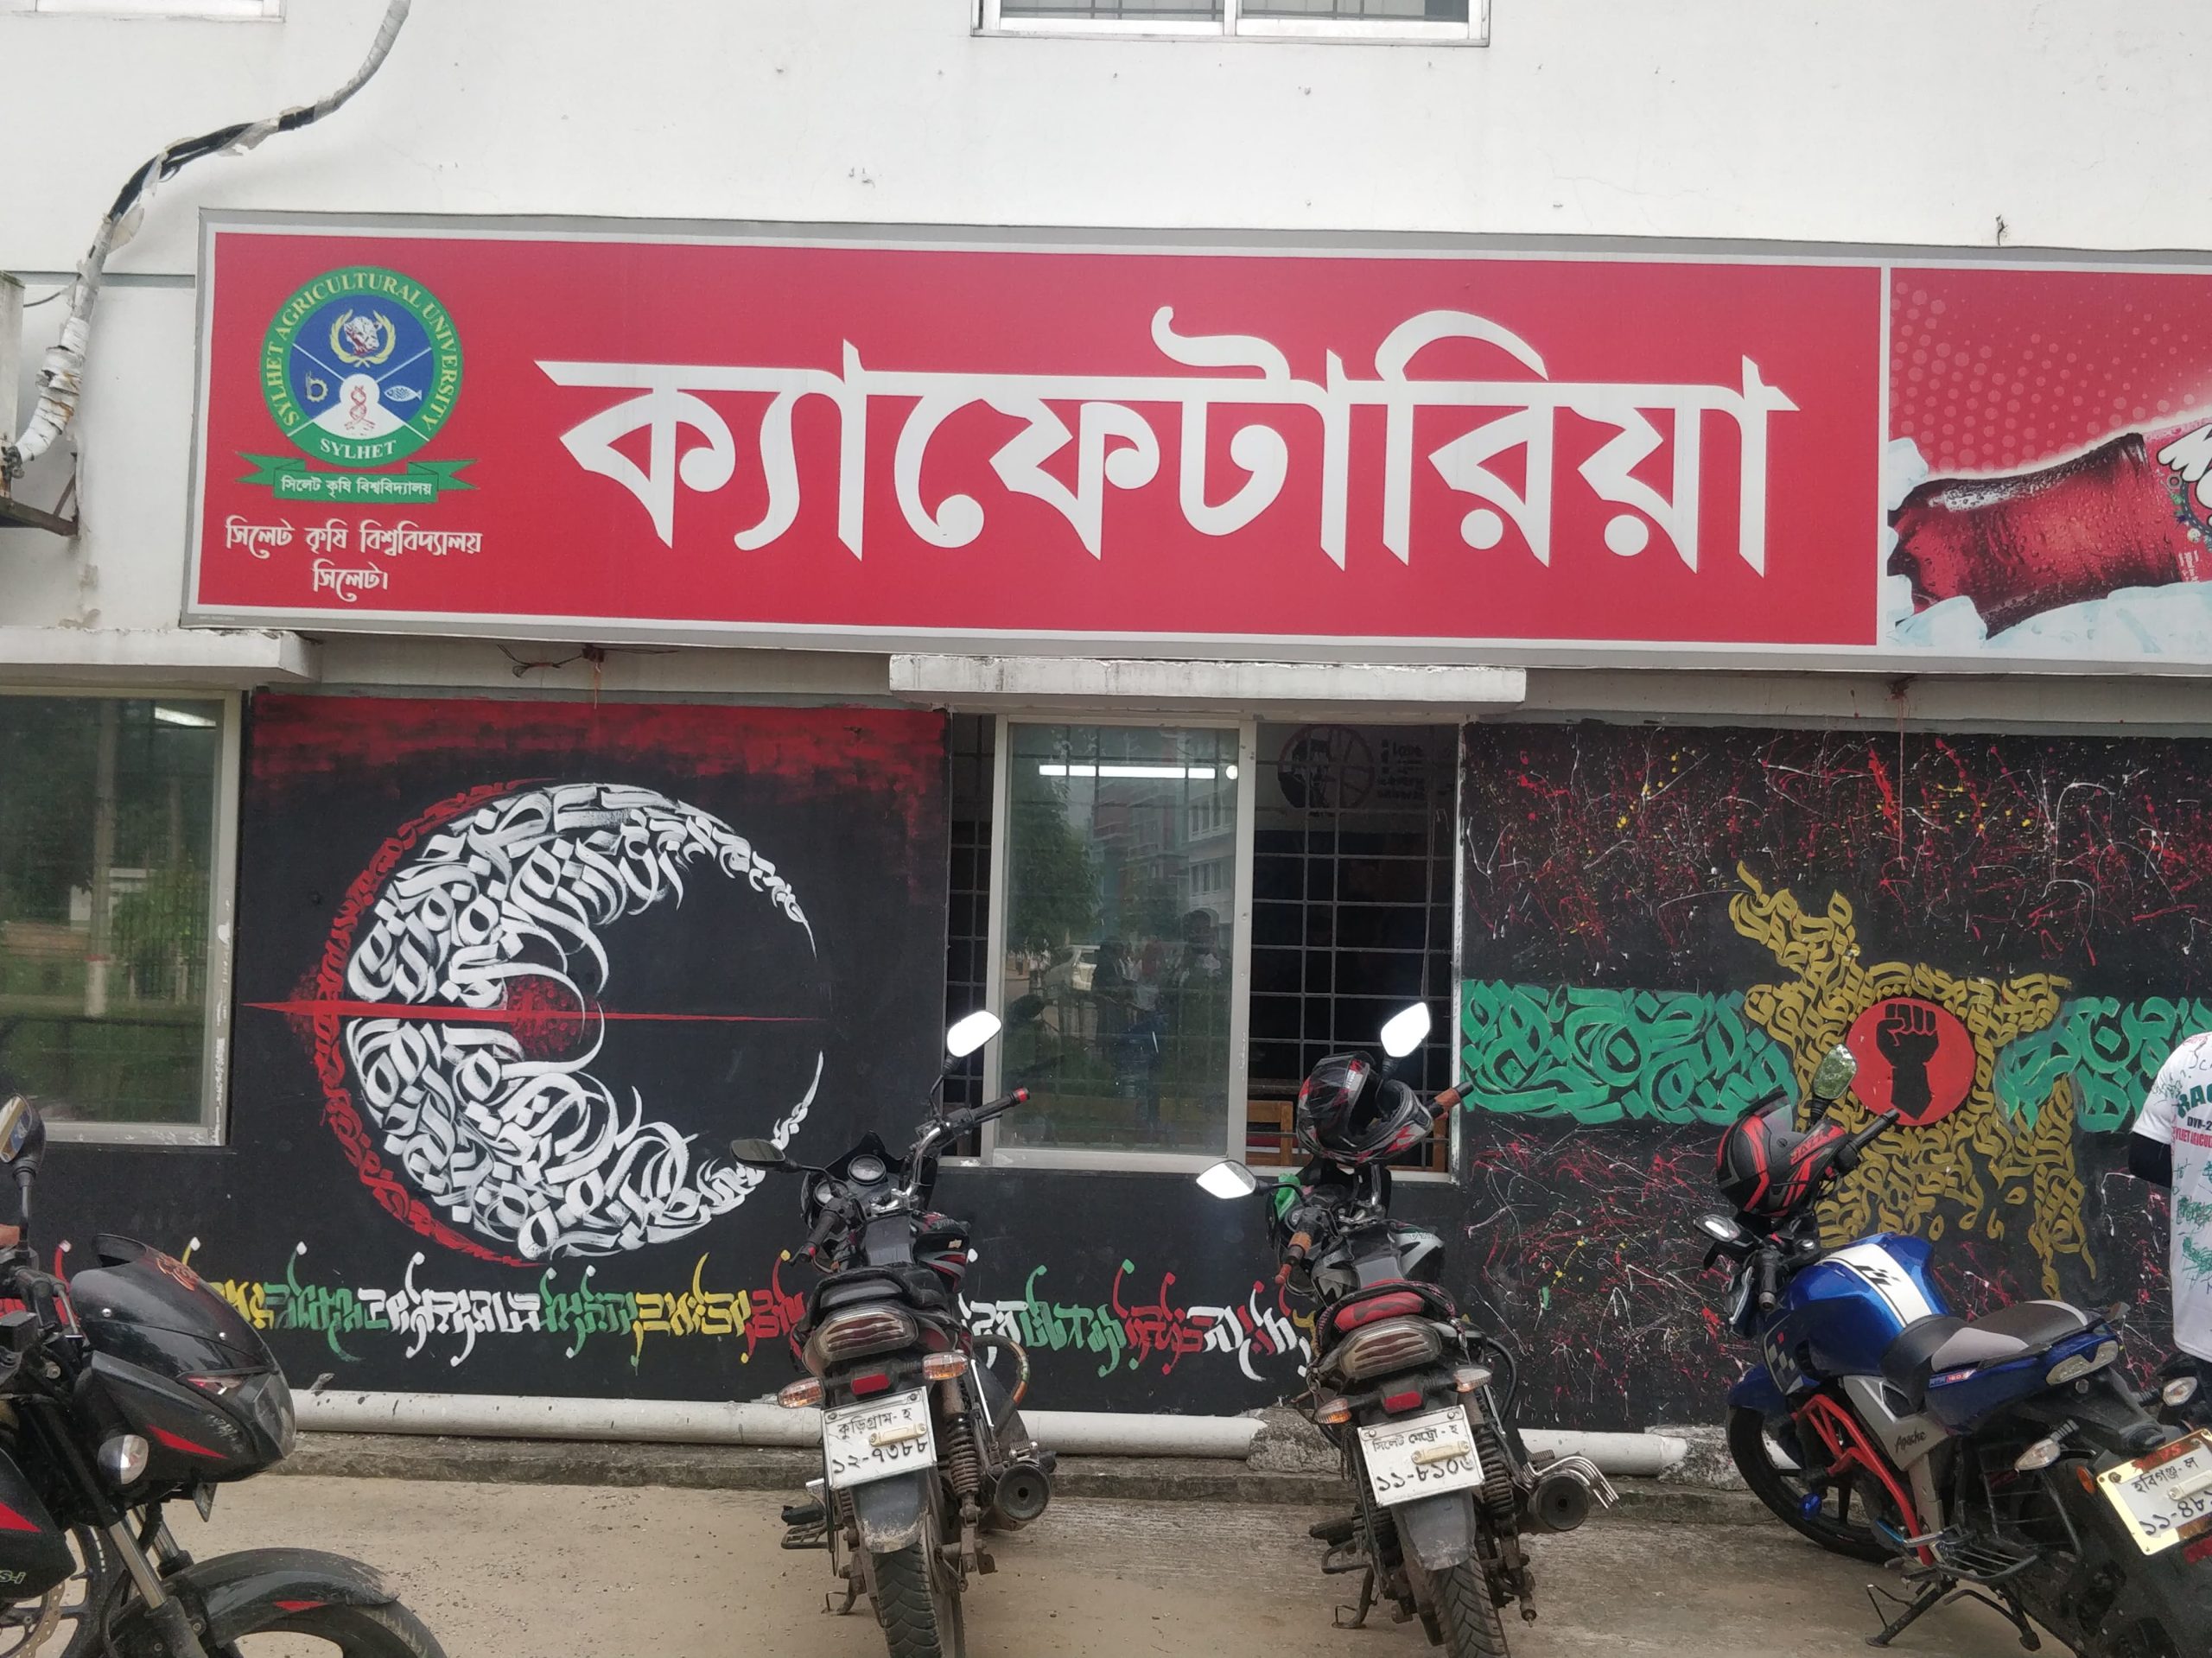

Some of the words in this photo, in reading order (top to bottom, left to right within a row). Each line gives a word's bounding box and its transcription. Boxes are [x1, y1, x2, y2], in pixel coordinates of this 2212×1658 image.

[278, 271, 423, 343] AGRICULTURAL
[265, 340, 300, 427] SYLHET
[421, 302, 460, 432] UNIVERSITY
[320, 437, 397, 461] SYLHET
[533, 305, 1801, 578] ক্যাফেটারিয়া
[281, 474, 322, 492] সিলেট
[325, 476, 352, 499] কৃষি
[356, 477, 433, 497] বিশ্ববিদ্যালয়
[225, 514, 296, 560] সিলেট
[304, 518, 349, 555] কৃষি
[359, 518, 484, 557] বিশ্ববিদ্যালয়
[1894, 1426, 1927, 1453] Apache
